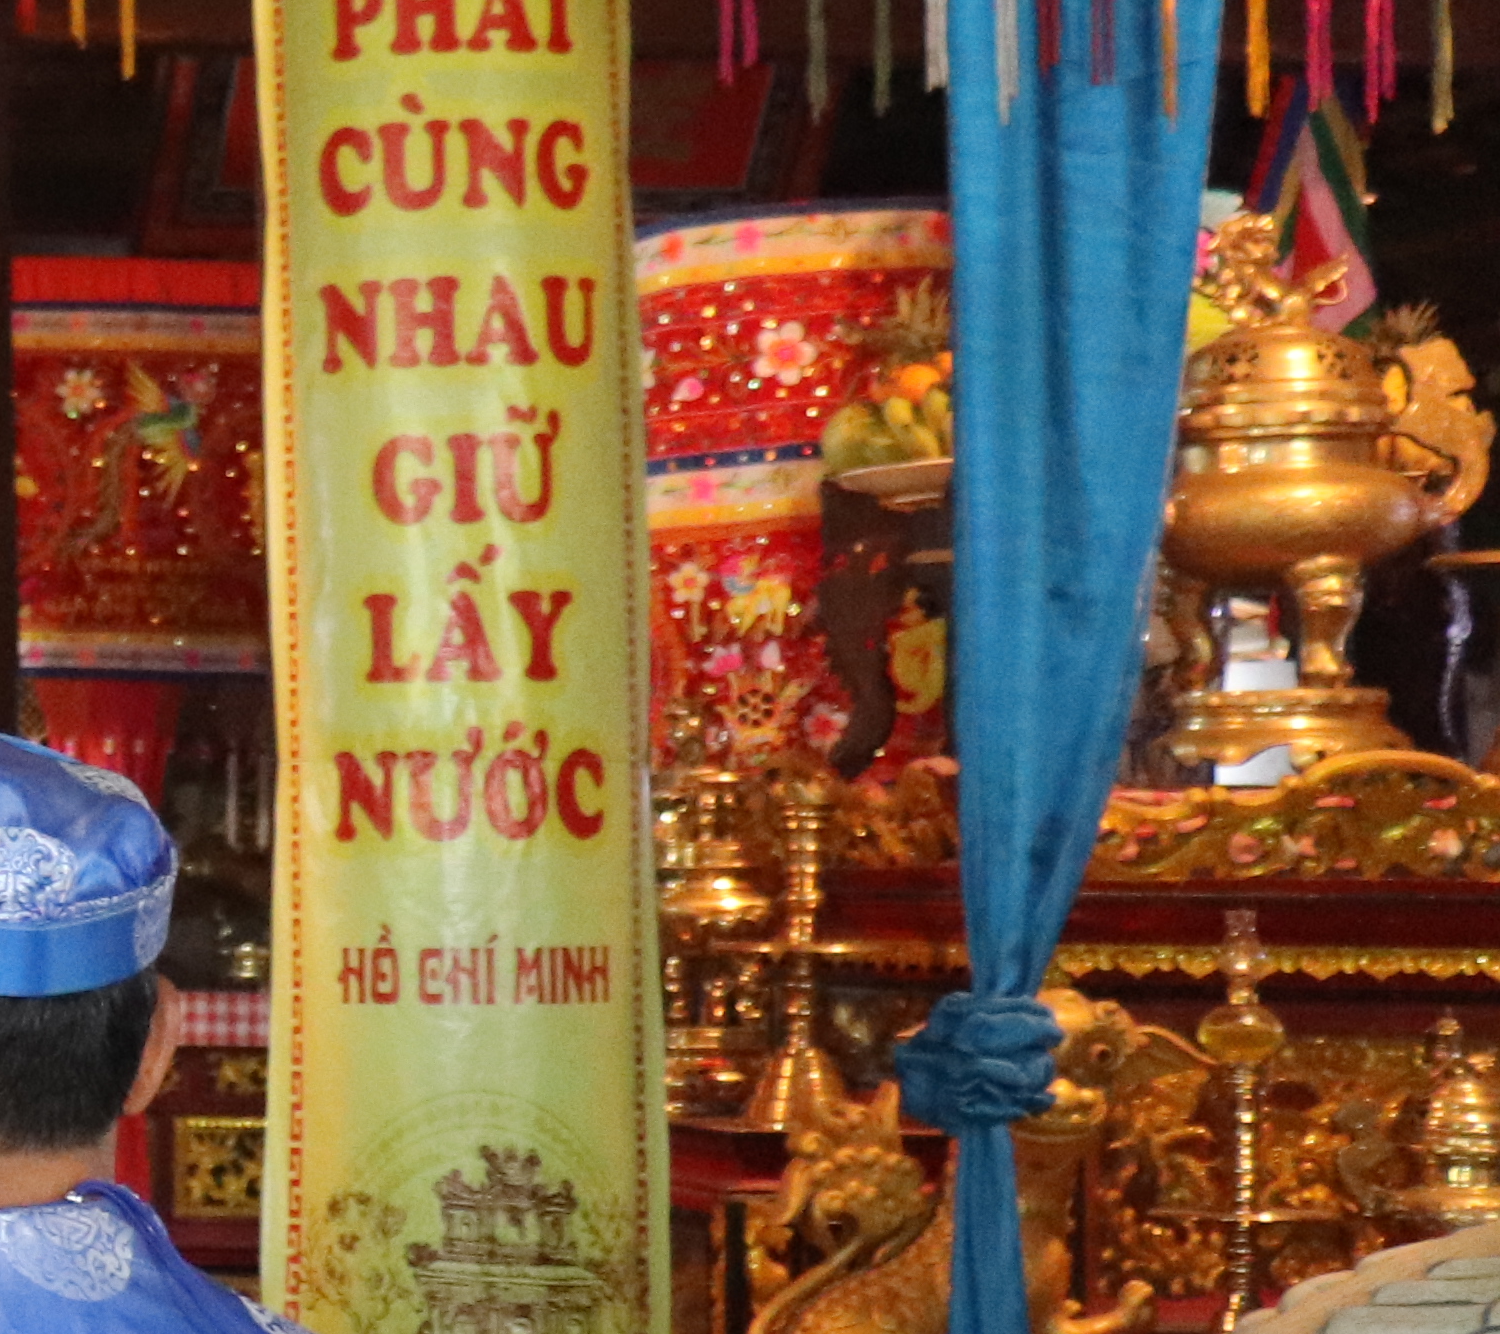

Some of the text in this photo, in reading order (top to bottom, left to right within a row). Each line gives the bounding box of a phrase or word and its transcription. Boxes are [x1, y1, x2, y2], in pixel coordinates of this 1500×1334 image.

[318, 90, 593, 219] CÙNG
[319, 274, 598, 376] NHAU
[370, 404, 563, 526] GIỮ
[363, 543, 575, 688] LẤY
[333, 715, 606, 845] NƯỚC
[337, 922, 612, 1006] HỒ CHÍ MINH
